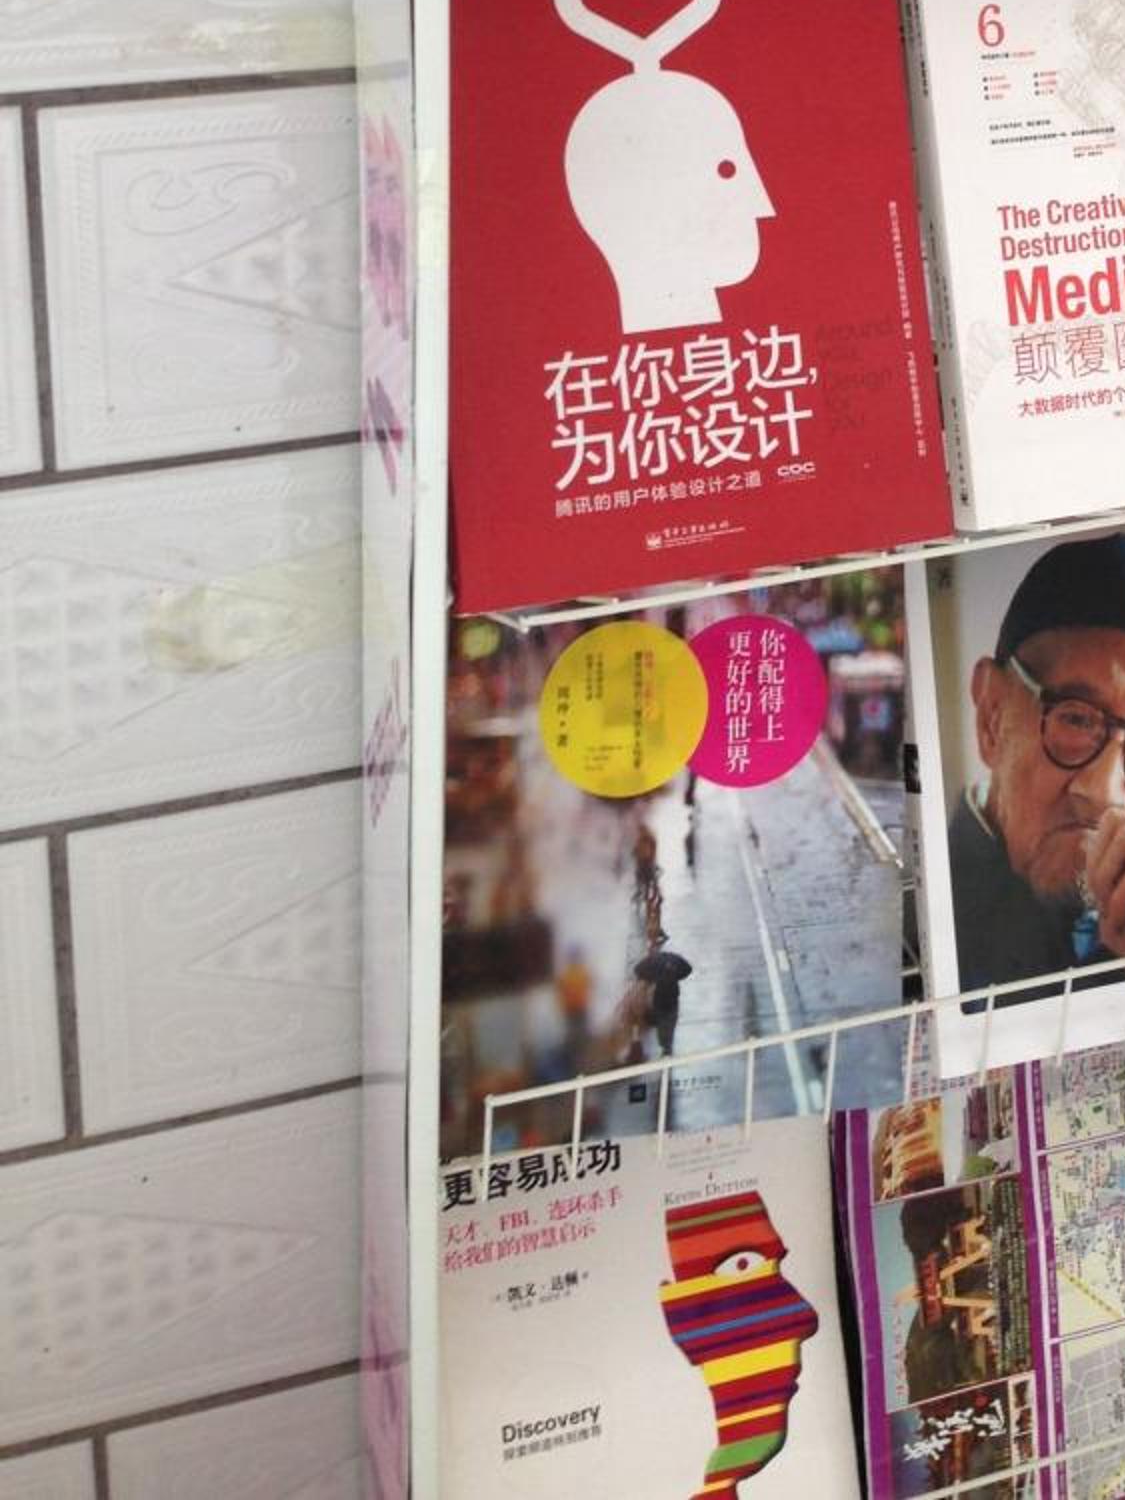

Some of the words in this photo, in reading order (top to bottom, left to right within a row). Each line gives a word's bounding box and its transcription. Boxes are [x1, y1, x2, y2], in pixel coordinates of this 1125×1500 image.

[976, 3, 1005, 48] 6
[997, 203, 1041, 232] The
[542, 324, 819, 422] 在你身边,
[549, 389, 814, 492] 为你设计
[555, 469, 763, 518] 腾讯的用户体验设计之道
[723, 630, 752, 774] 更好的世界
[757, 628, 786, 743] 你配得上
[441, 1140, 621, 1212] 更容易成功
[501, 1404, 601, 1444] Discovery
